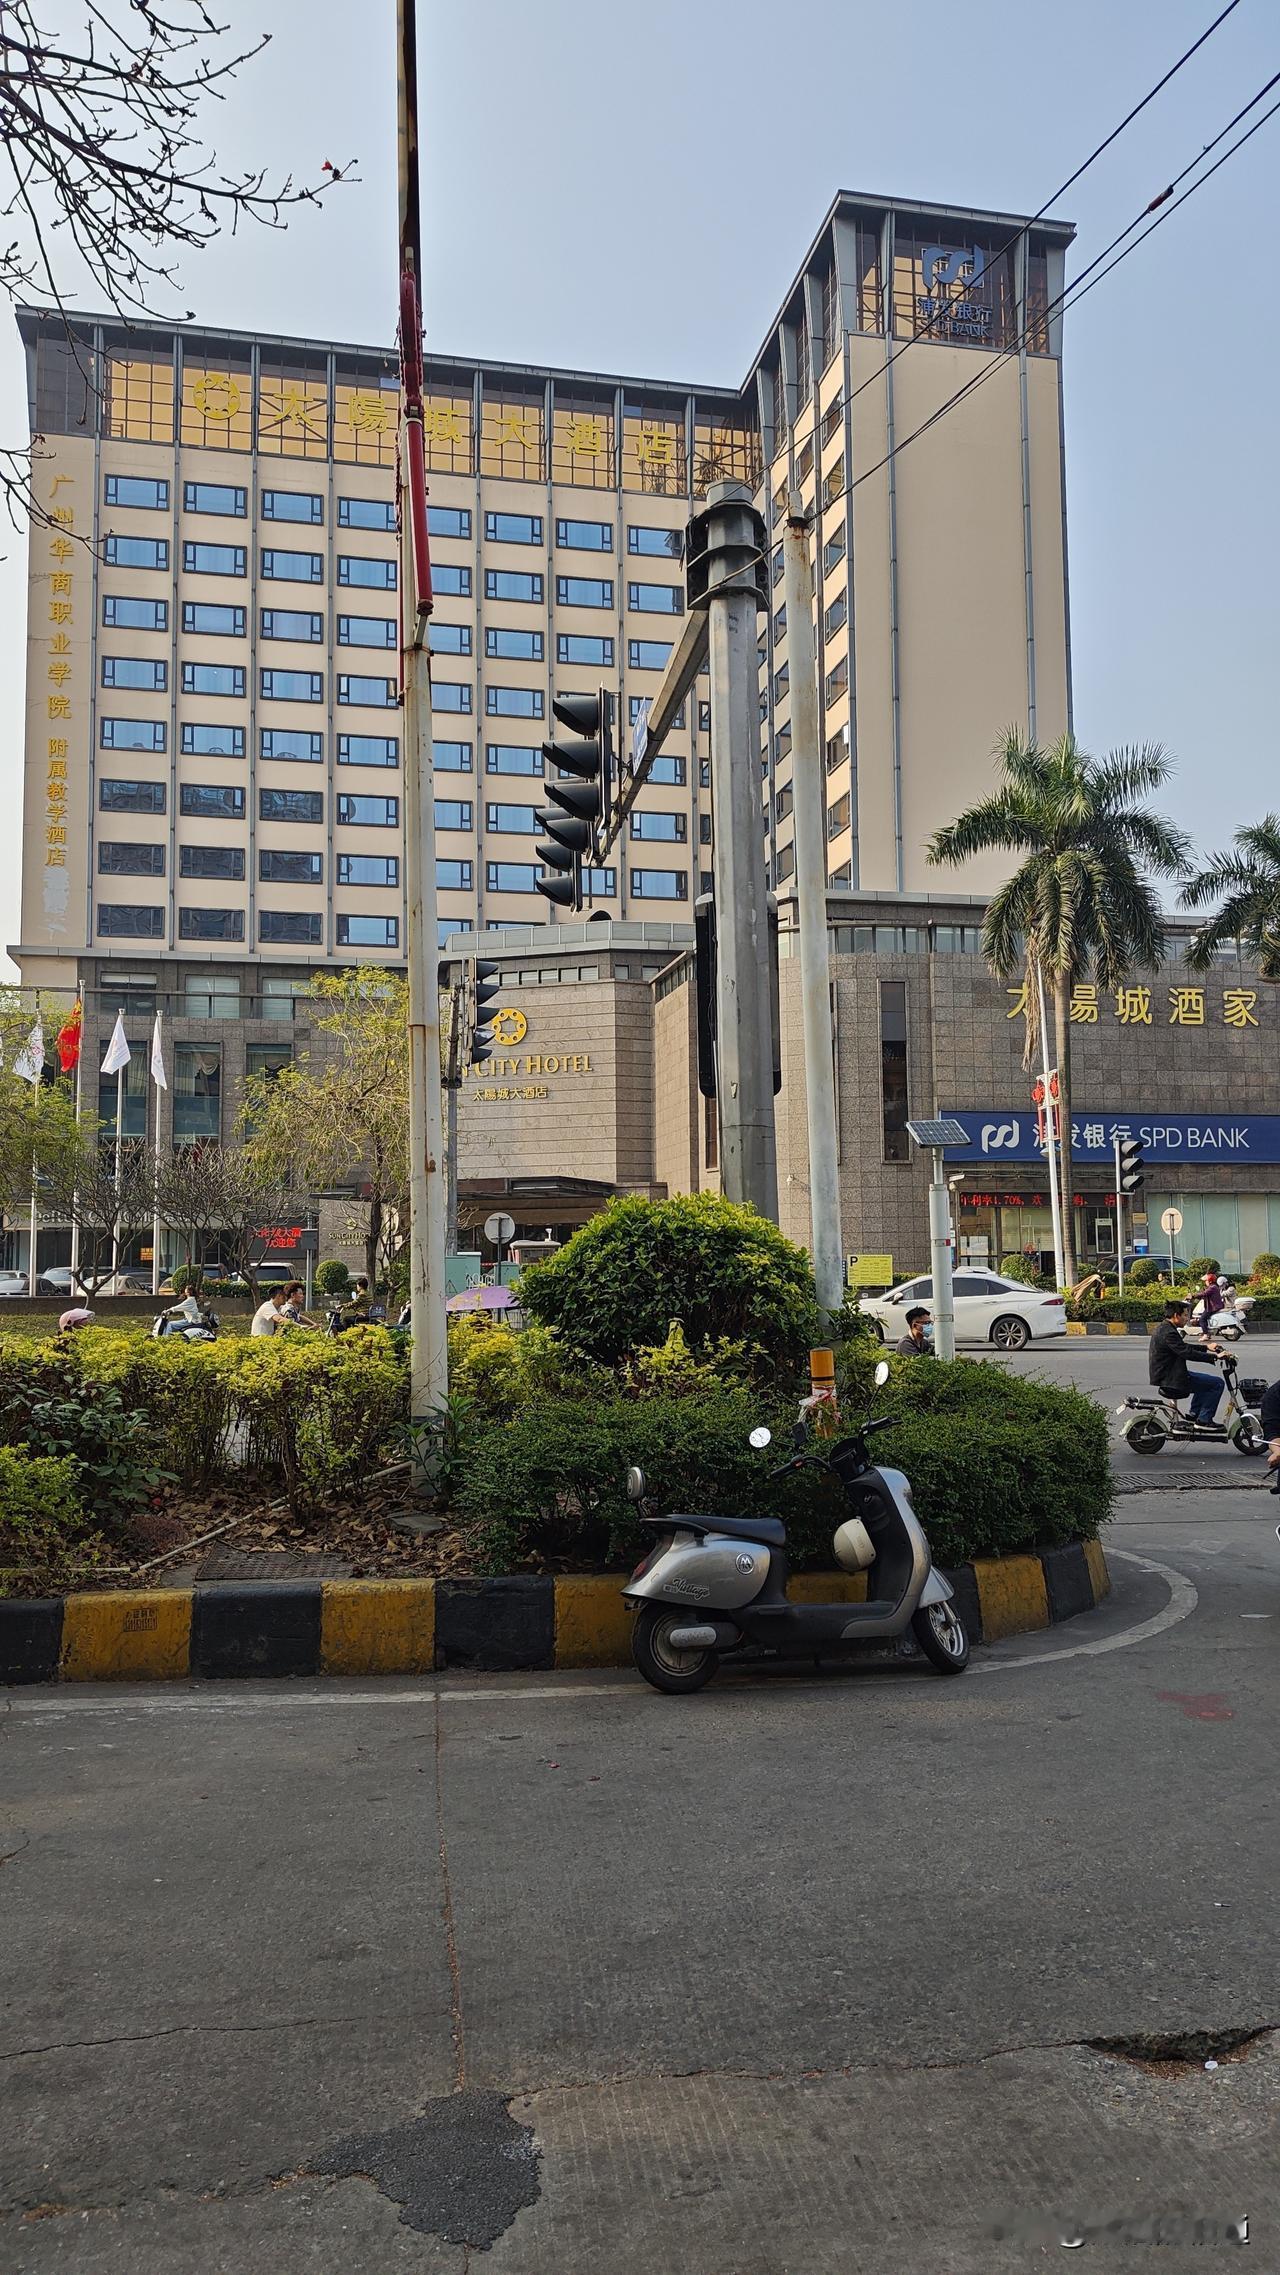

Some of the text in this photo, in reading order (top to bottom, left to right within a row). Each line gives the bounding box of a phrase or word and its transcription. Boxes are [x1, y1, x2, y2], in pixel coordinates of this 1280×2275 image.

[45, 473, 75, 866] 广州华商职业学院 附属教学酒店
[526, 1055, 593, 1075] HOTEL
[472, 1086, 548, 1102] 太陽城大酒店
[1140, 1126, 1250, 1148] SPD BANK
[850, 1256, 858, 1267] P
[673, 1578, 710, 1600] Vintage
